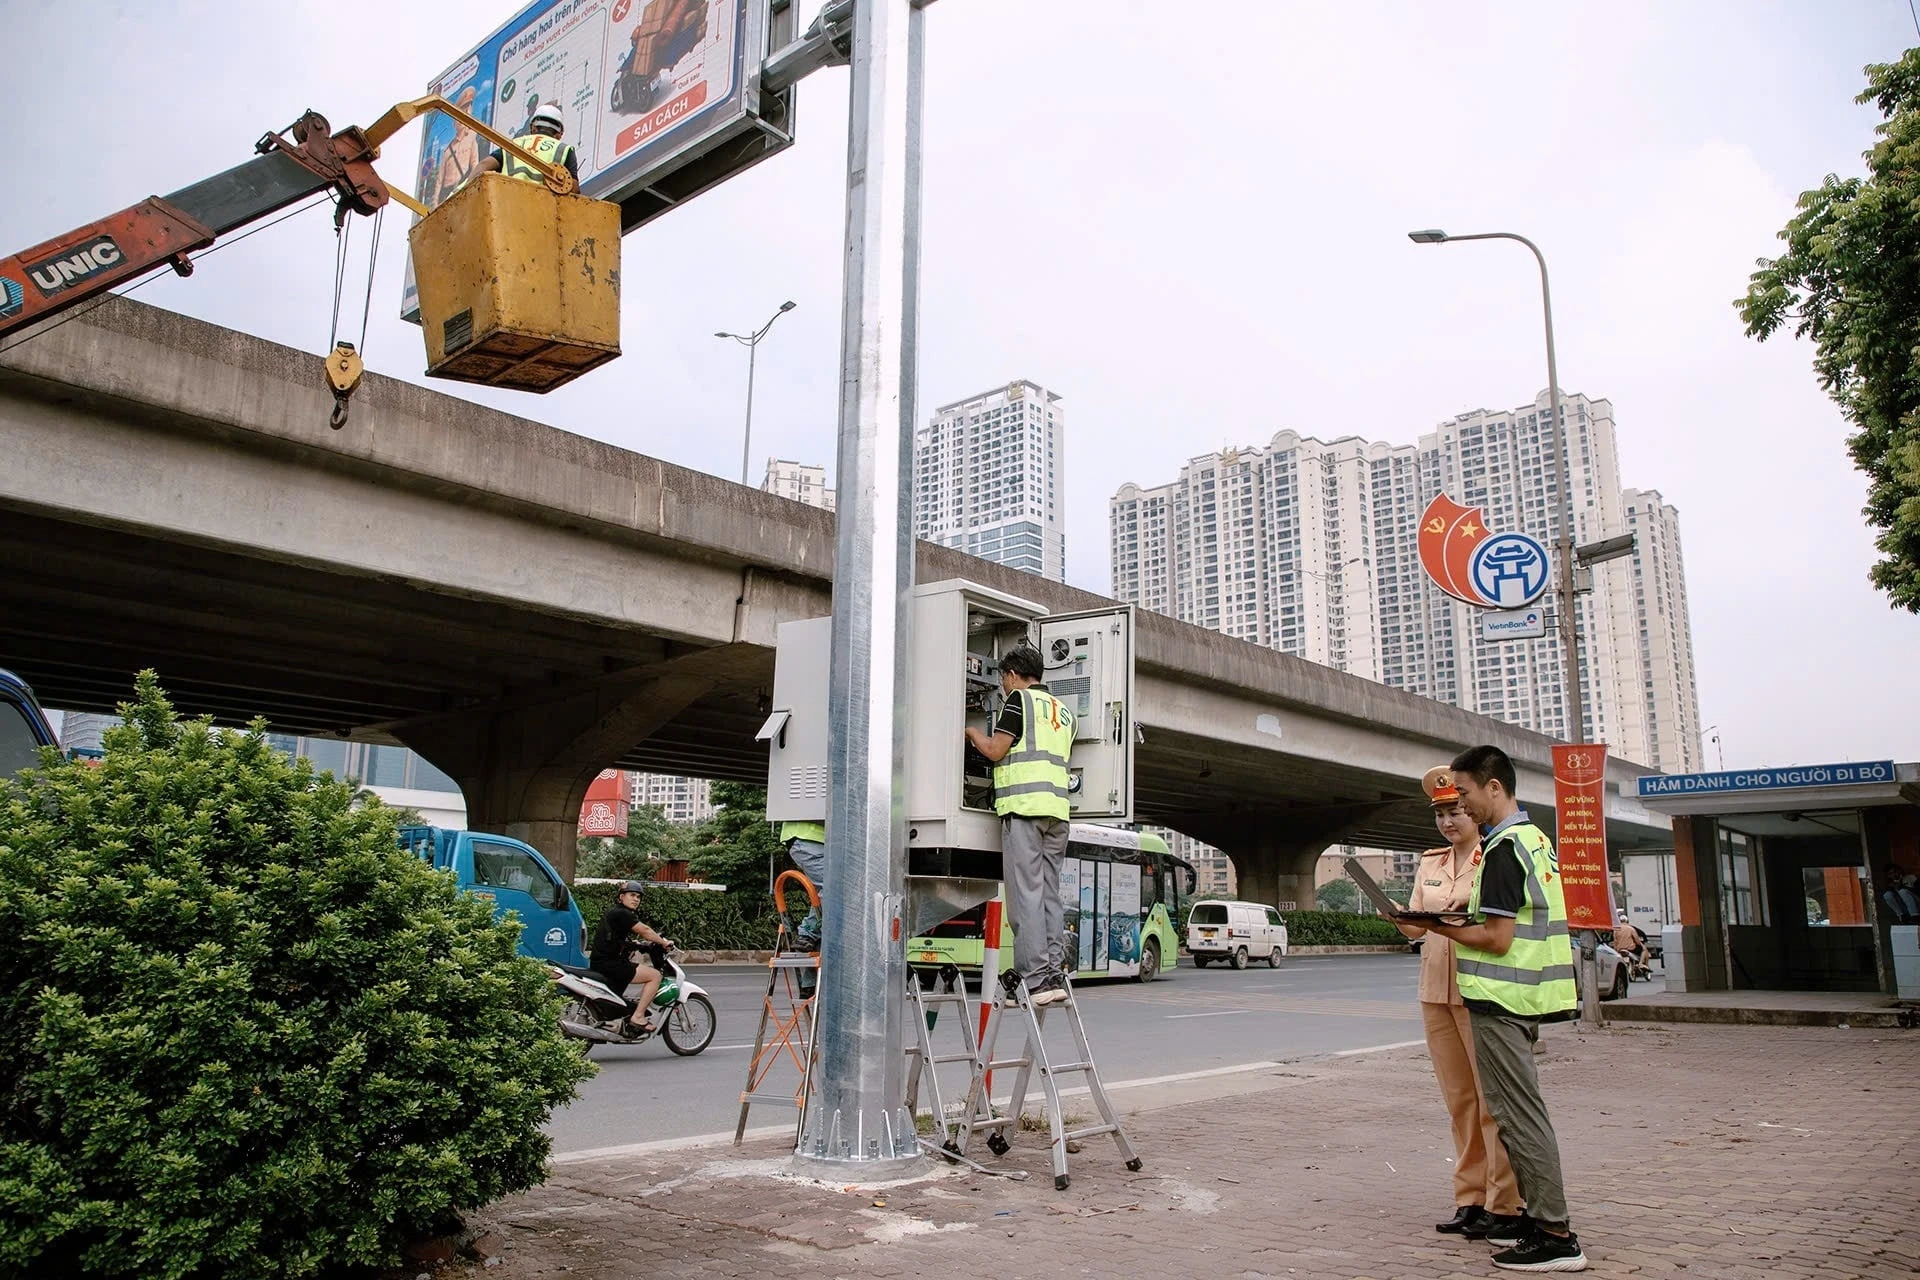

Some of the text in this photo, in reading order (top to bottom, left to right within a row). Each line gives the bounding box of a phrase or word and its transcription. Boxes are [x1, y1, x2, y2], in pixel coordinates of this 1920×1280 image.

[518, 30, 537, 52] hàng
[554, 4, 571, 24] trên
[633, 96, 689, 140] SAI CÁCH
[31, 242, 120, 290] UNIC
[1488, 620, 1527, 630] VietinBank
[1684, 775, 1730, 790] DÀNH
[1735, 774, 1771, 787] CHO
[1776, 767, 1831, 785] NGƯỜI
[1836, 768, 1854, 781] ĐI
[1859, 763, 1885, 781] BỘ
[593, 806, 609, 817] Xin
[1576, 849, 1586, 858] VÀ
